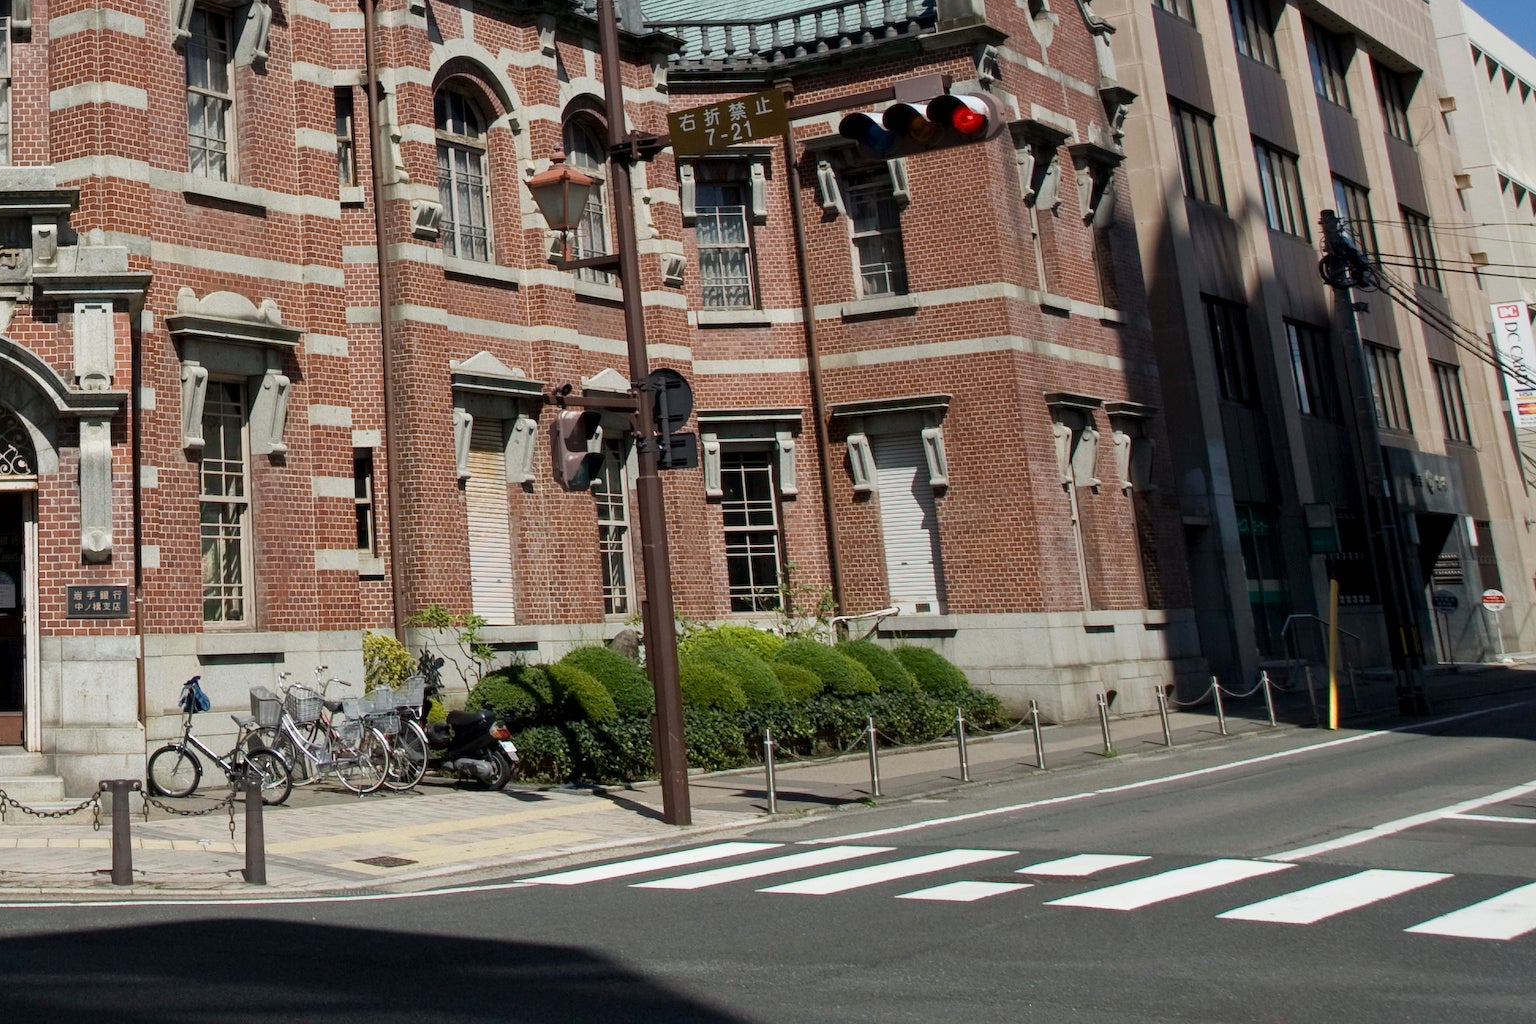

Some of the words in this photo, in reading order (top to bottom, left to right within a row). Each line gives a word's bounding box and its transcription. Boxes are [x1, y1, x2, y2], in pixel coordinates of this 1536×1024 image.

[678, 96, 773, 132] 右折禁止
[705, 120, 753, 146] 7-21
[1505, 322, 1521, 343] DC
[73, 590, 123, 601] 岩手銀行
